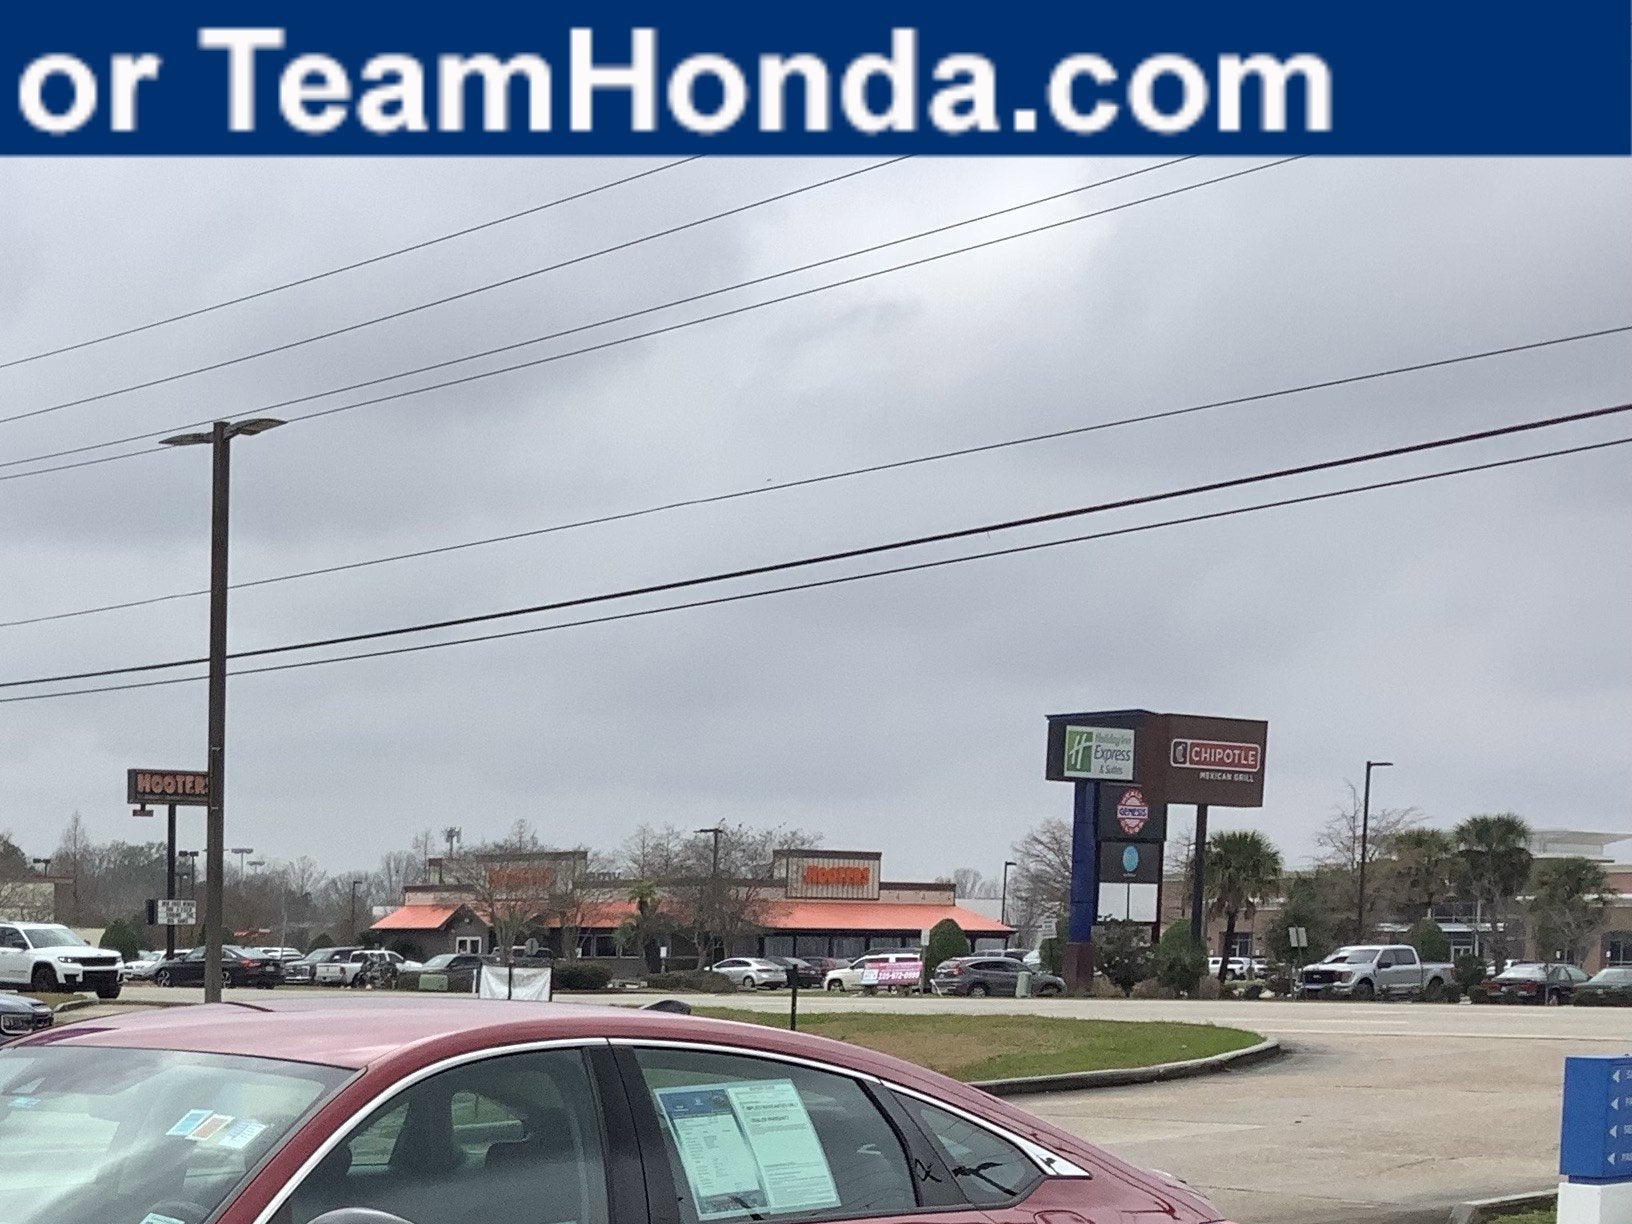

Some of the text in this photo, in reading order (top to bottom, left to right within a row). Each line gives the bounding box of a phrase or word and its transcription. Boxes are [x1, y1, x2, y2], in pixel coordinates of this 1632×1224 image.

[1093, 744, 1131, 763] Express
[1191, 747, 1256, 765] CHIPOTLE
[137, 773, 208, 794] HOOTER
[1199, 771, 1232, 780] MEXICAN
